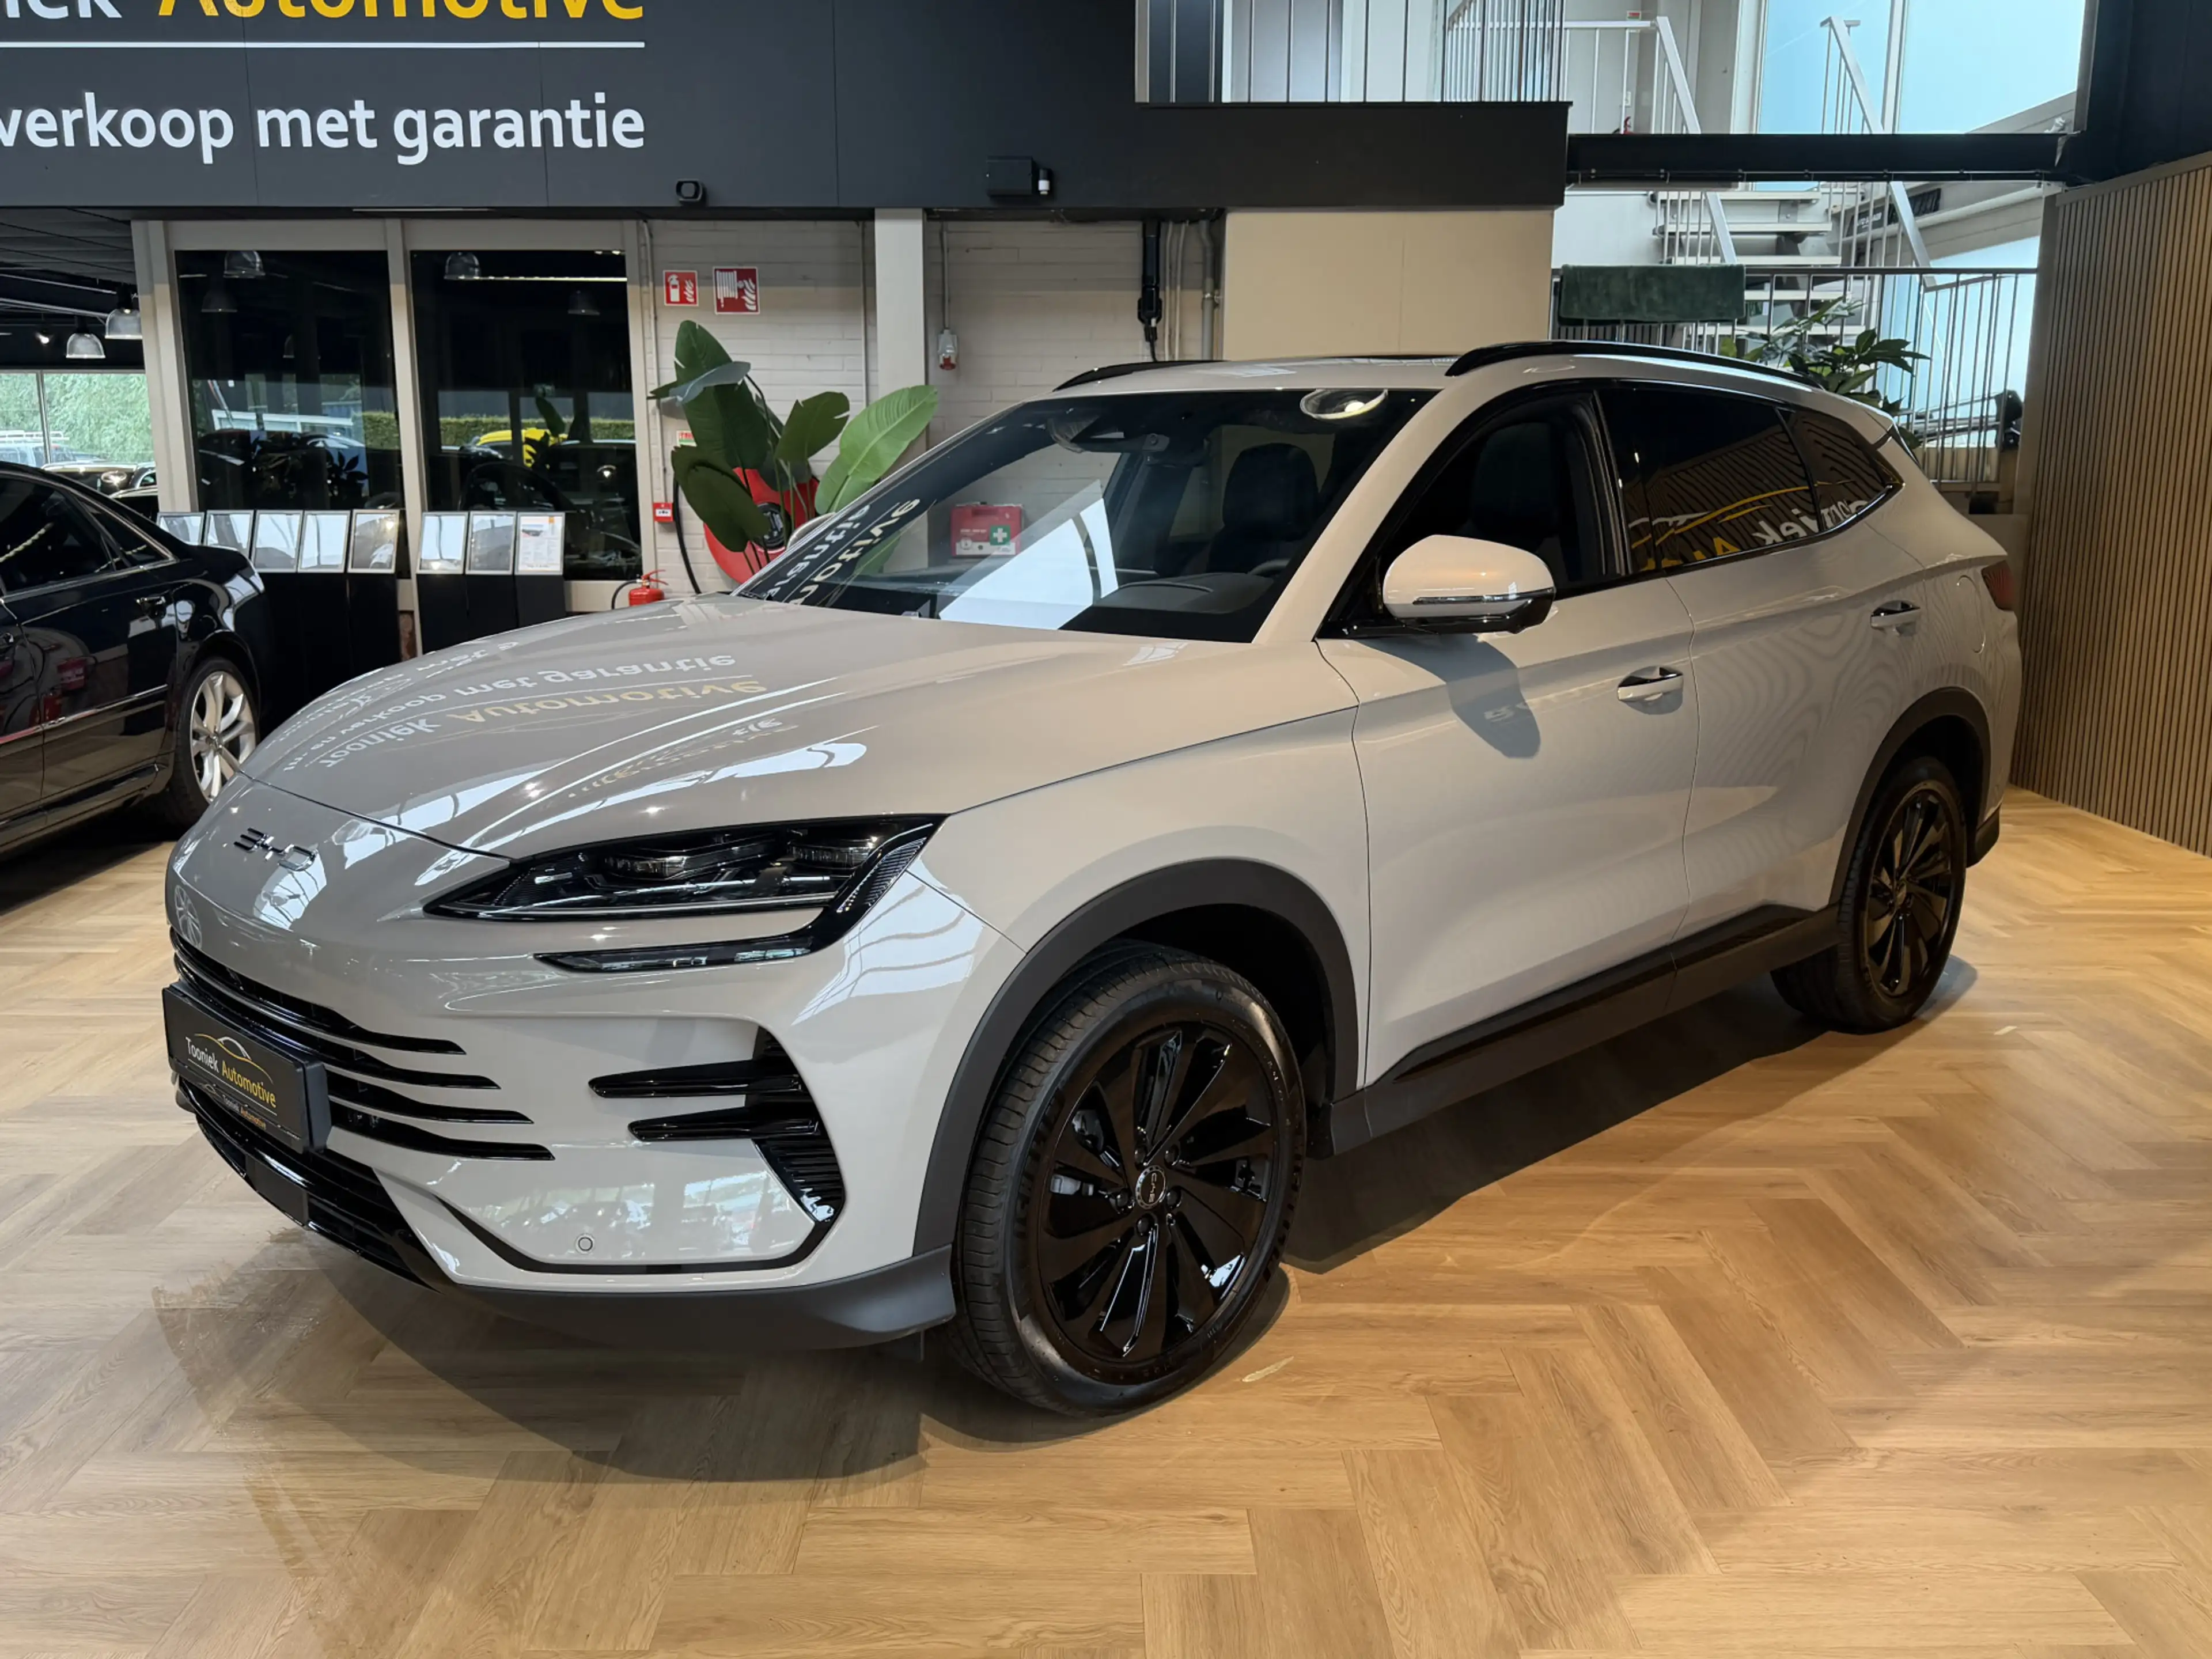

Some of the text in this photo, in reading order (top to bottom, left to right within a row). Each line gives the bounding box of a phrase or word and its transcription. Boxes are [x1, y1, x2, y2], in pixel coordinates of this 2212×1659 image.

[0, 92, 645, 165] verkoop met garantie
[185, 1036, 276, 1108] Tooniek Automotive
